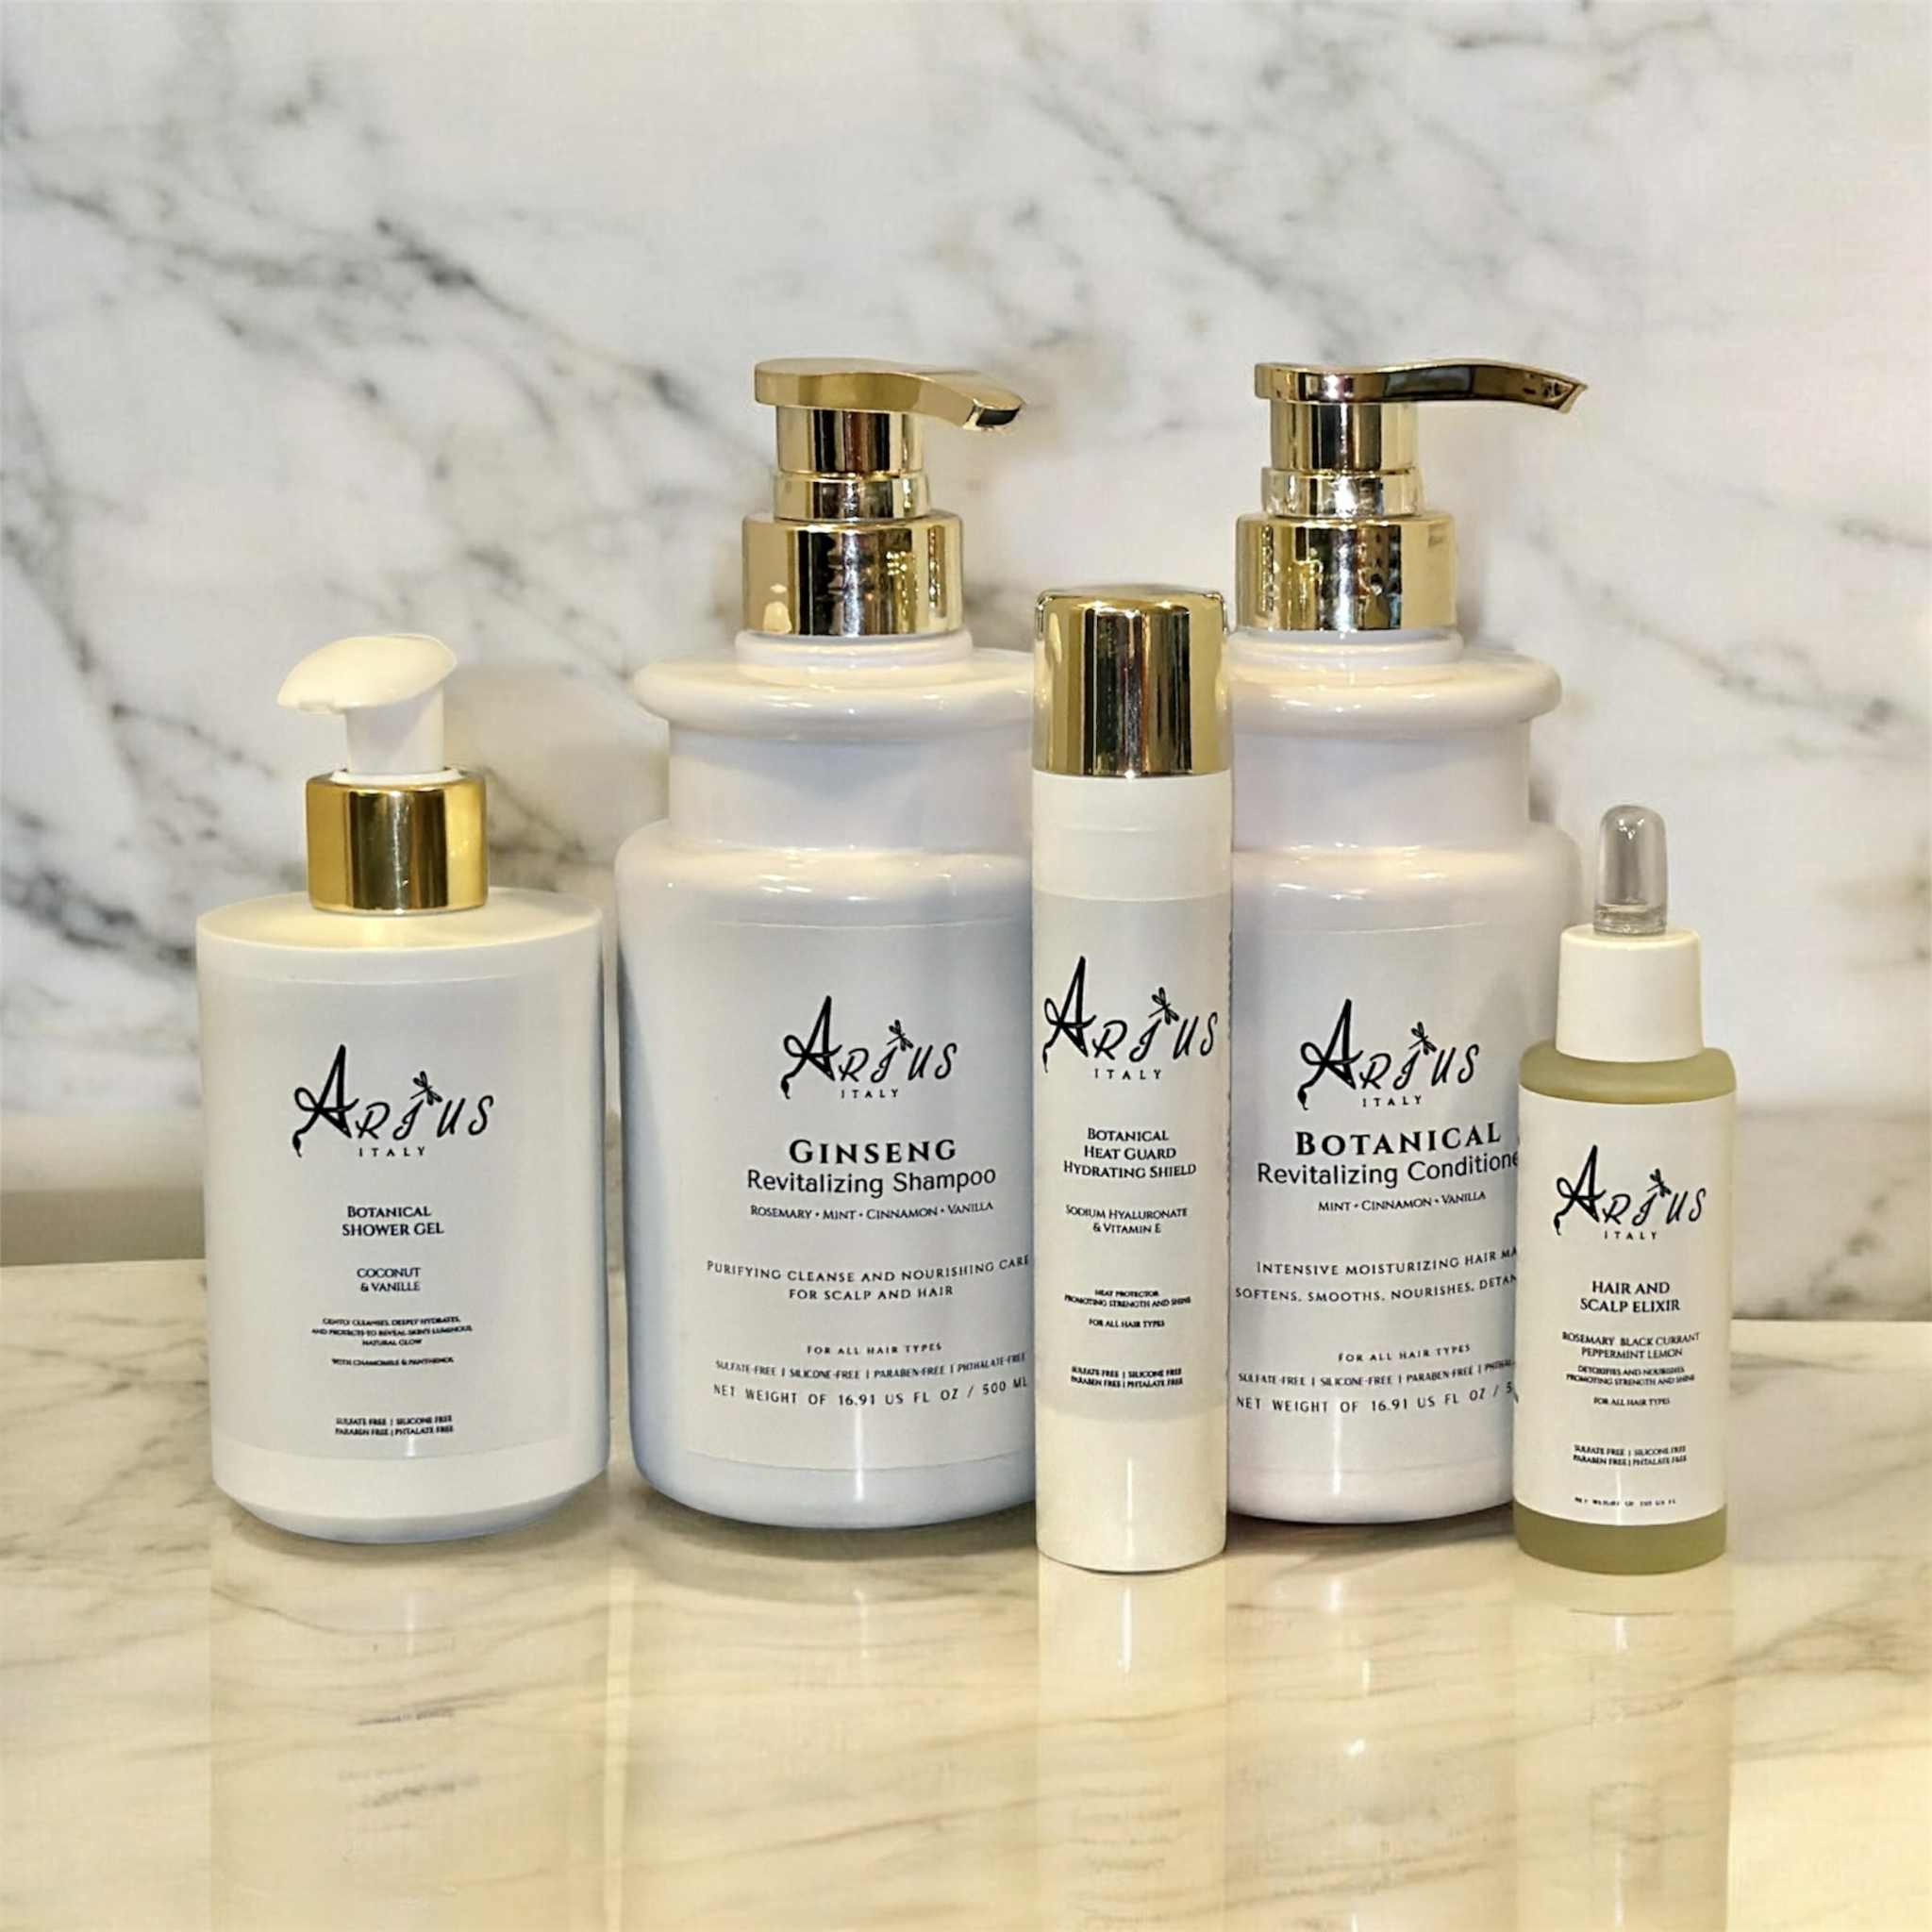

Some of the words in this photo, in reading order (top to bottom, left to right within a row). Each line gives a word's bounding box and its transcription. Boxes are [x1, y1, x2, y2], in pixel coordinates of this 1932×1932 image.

[1095, 1069, 1162, 1079] ITALY
[841, 1089, 898, 1098] ITALY
[1362, 1095, 1422, 1108] ITALY
[1087, 1128, 1169, 1141] BOTANICAL
[1296, 1122, 1501, 1156] BOTANICAL
[359, 1147, 425, 1157] ITALY
[790, 1139, 956, 1164] GINSENG
[1084, 1145, 1120, 1159] HEAT
[1124, 1147, 1176, 1160] GUARD
[1064, 1160, 1146, 1178] HYDRATING
[1149, 1164, 1196, 1178] SHIELD
[1257, 1162, 1397, 1189] Revitalizing
[747, 1169, 883, 1198] Revitalizing
[892, 1169, 996, 1192] Shampoo
[1318, 1202, 1349, 1211] MINT
[1361, 1198, 1432, 1210] CINNAMON
[1441, 1191, 1486, 1204] VANILLA
[347, 1206, 431, 1218] BOTANICAL
[750, 1205, 812, 1219] ROSEMARY
[823, 1208, 856, 1220] MINT
[866, 1207, 938, 1220] CINNAMON
[947, 1202, 993, 1214] VANILLA
[1065, 1205, 1106, 1218] SODIUM
[1108, 1208, 1187, 1220] HYALURONATE
[342, 1224, 408, 1236] SHOWER
[414, 1223, 444, 1235] GEL
[1093, 1223, 1101, 1232] &
[1104, 1224, 1152, 1234] VITAMIN
[1155, 1224, 1161, 1233] E
[1605, 1231, 1657, 1240] ITALY
[708, 1260, 781, 1279] PURIFYING
[788, 1271, 855, 1282] CLEANSE
[861, 1271, 895, 1282] AND
[901, 1262, 994, 1281] NOURISHING
[999, 1255, 1030, 1270] CARE
[1257, 1261, 1339, 1274] INTENSIVE
[1345, 1257, 1459, 1275] MOISTURIZING
[1464, 1252, 1496, 1265] HAIR
[357, 1267, 421, 1278] COCONUT
[360, 1283, 368, 1291] &
[372, 1282, 420, 1291] VANILLE
[789, 1289, 818, 1299] FOR
[824, 1290, 872, 1300] SCALP
[877, 1289, 911, 1299] AND
[918, 1285, 954, 1297] HAIR
[1235, 1288, 1302, 1302] SOFTENS,
[1307, 1291, 1385, 1303] SMOOTHS,
[1391, 1282, 1474, 1300] NOURISHES,
[1592, 1281, 1631, 1294] HAIR
[1635, 1281, 1670, 1294] AND
[1580, 1298, 1628, 1312] SCALP
[1633, 1299, 1680, 1313] ELIXIR
[1562, 1331, 1615, 1345] ROSEMARY
[1621, 1337, 1653, 1346] BLACK
[1656, 1332, 1700, 1345] CURRANT
[807, 1346, 831, 1355] FOR
[838, 1346, 859, 1355] ALL
[866, 1345, 899, 1355] HAIR
[906, 1342, 941, 1353] TYPES
[1339, 1353, 1363, 1362] FOR
[1370, 1352, 1391, 1360] ALL
[1399, 1350, 1429, 1359] HAIR
[1436, 1343, 1470, 1355] TYPES
[1581, 1347, 1645, 1358] PEPPERMINT
[1647, 1348, 1683, 1358] LEMON
[1566, 1374, 1612, 1385] PROMOTING
[713, 1384, 735, 1397] NET
[745, 1388, 797, 1404] WEIGHT
[808, 1394, 826, 1405] OF
[839, 1394, 875, 1406] 16.91
[885, 1393, 904, 1405] US
[913, 1391, 929, 1403] FL
[941, 1389, 958, 1400] OZ
[982, 1381, 1007, 1395] 500
[1013, 1376, 1027, 1390] ML
[1237, 1396, 1260, 1409] NET
[1272, 1400, 1328, 1413] WEIGHT
[1340, 1402, 1358, 1413] OF
[1371, 1399, 1408, 1411] 16.91
[1417, 1396, 1435, 1408] US
[1444, 1393, 1458, 1404] FL
[1469, 1389, 1486, 1401] OZ
